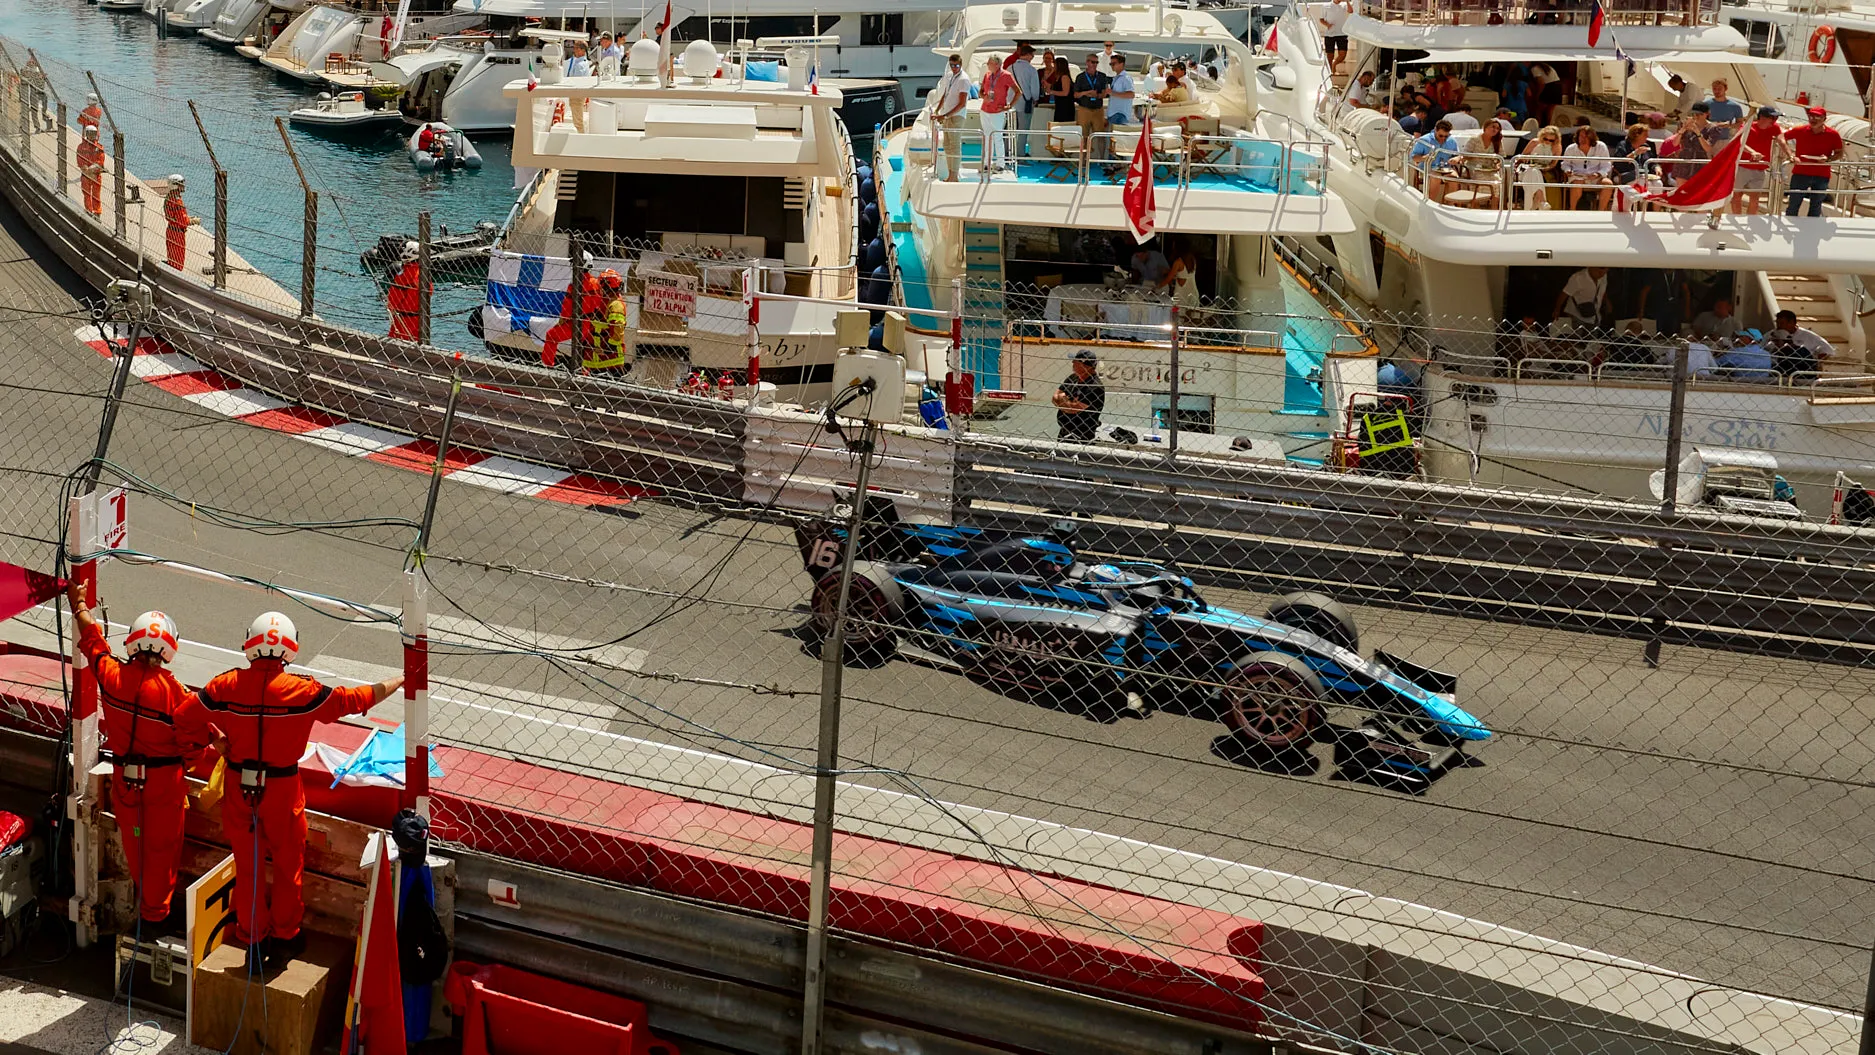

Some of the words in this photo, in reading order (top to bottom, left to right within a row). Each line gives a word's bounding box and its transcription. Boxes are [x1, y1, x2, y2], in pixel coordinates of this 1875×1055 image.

[648, 276, 678, 287] SECTEUR
[687, 282, 695, 290] 12
[649, 289, 694, 302] INTERVENTION
[653, 299, 662, 310] 12
[664, 301, 687, 313] ALPHA
[1702, 419, 1777, 449] Star
[104, 523, 126, 543] FIRE
[808, 538, 840, 569] 16
[147, 622, 161, 639] S
[266, 628, 280, 646] S
